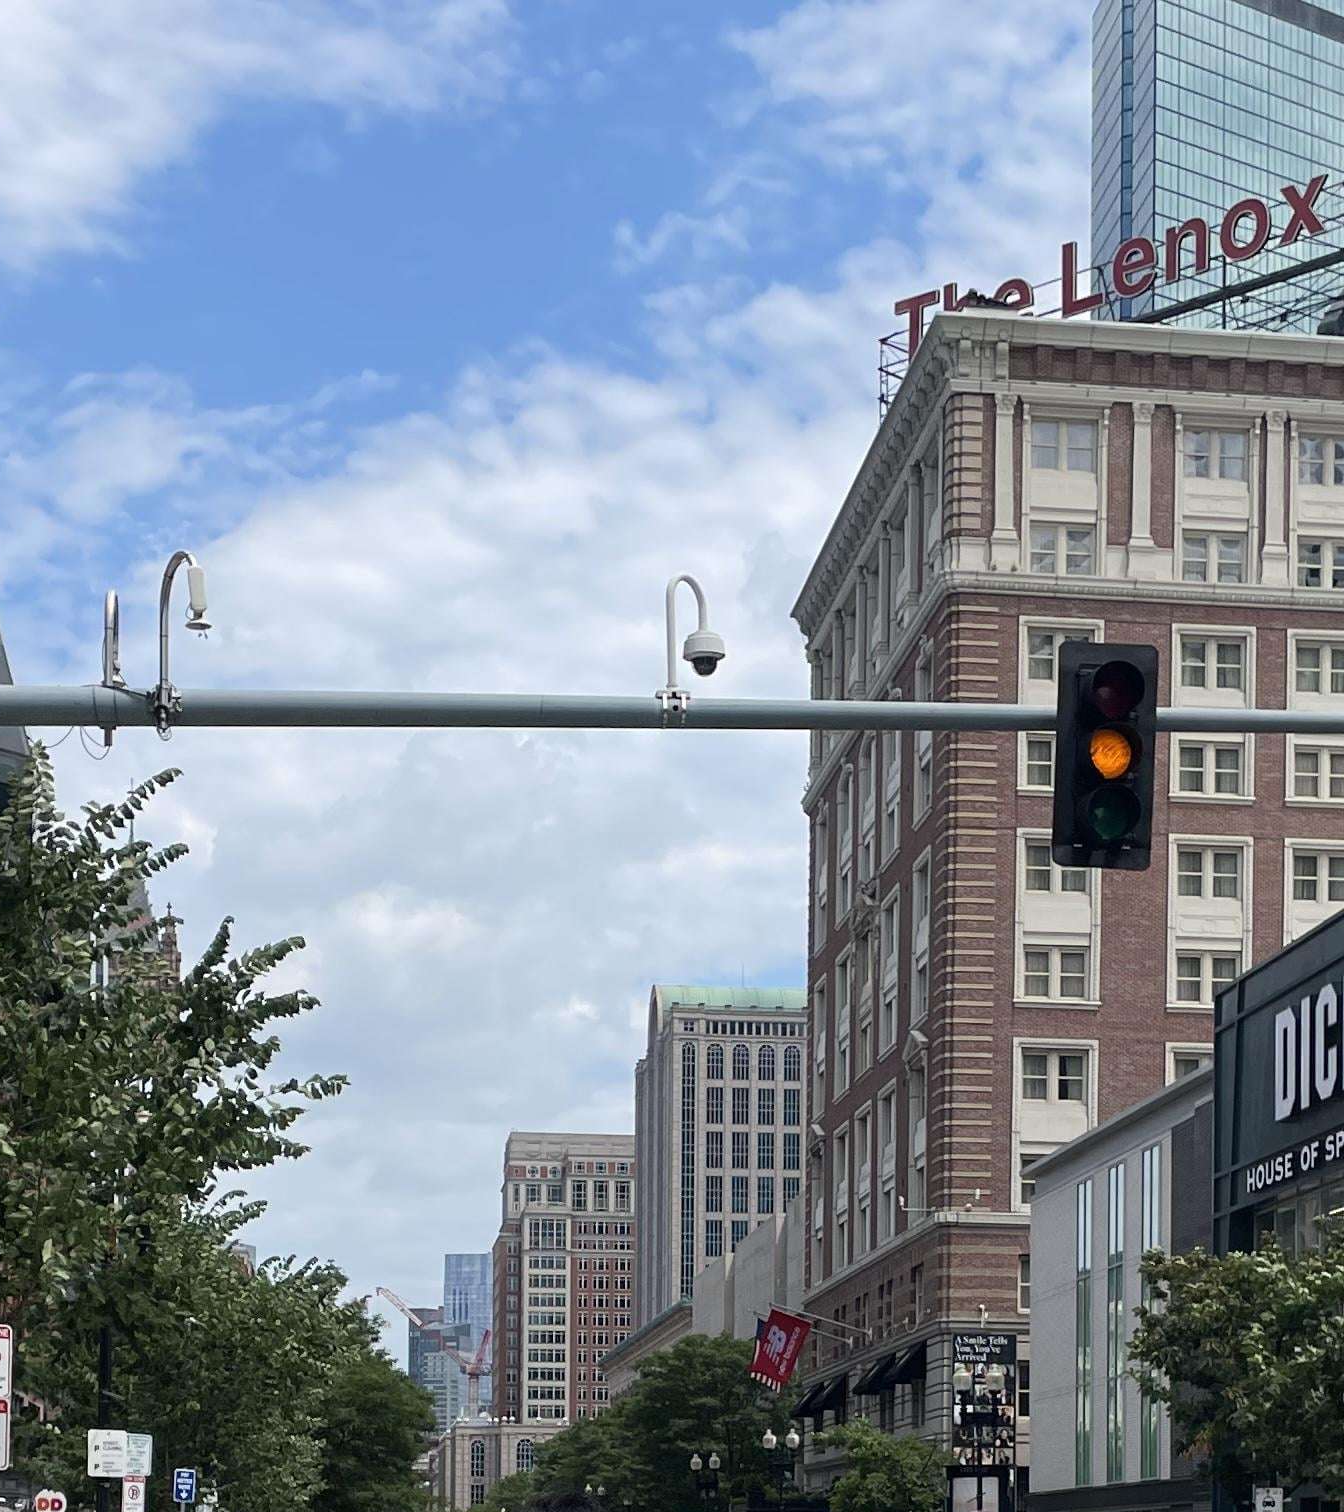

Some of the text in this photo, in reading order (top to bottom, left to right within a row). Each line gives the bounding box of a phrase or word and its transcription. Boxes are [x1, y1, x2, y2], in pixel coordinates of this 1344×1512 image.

[1061, 173, 1330, 319] Lenox
[1246, 1152, 1293, 1194] HOUSE
[1301, 1141, 1320, 1172] OF
[963, 1335, 987, 1345] Smile
[988, 1336, 1008, 1345] Tells
[955, 1352, 987, 1361] Arrived
[37, 1497, 63, 1511] DD
